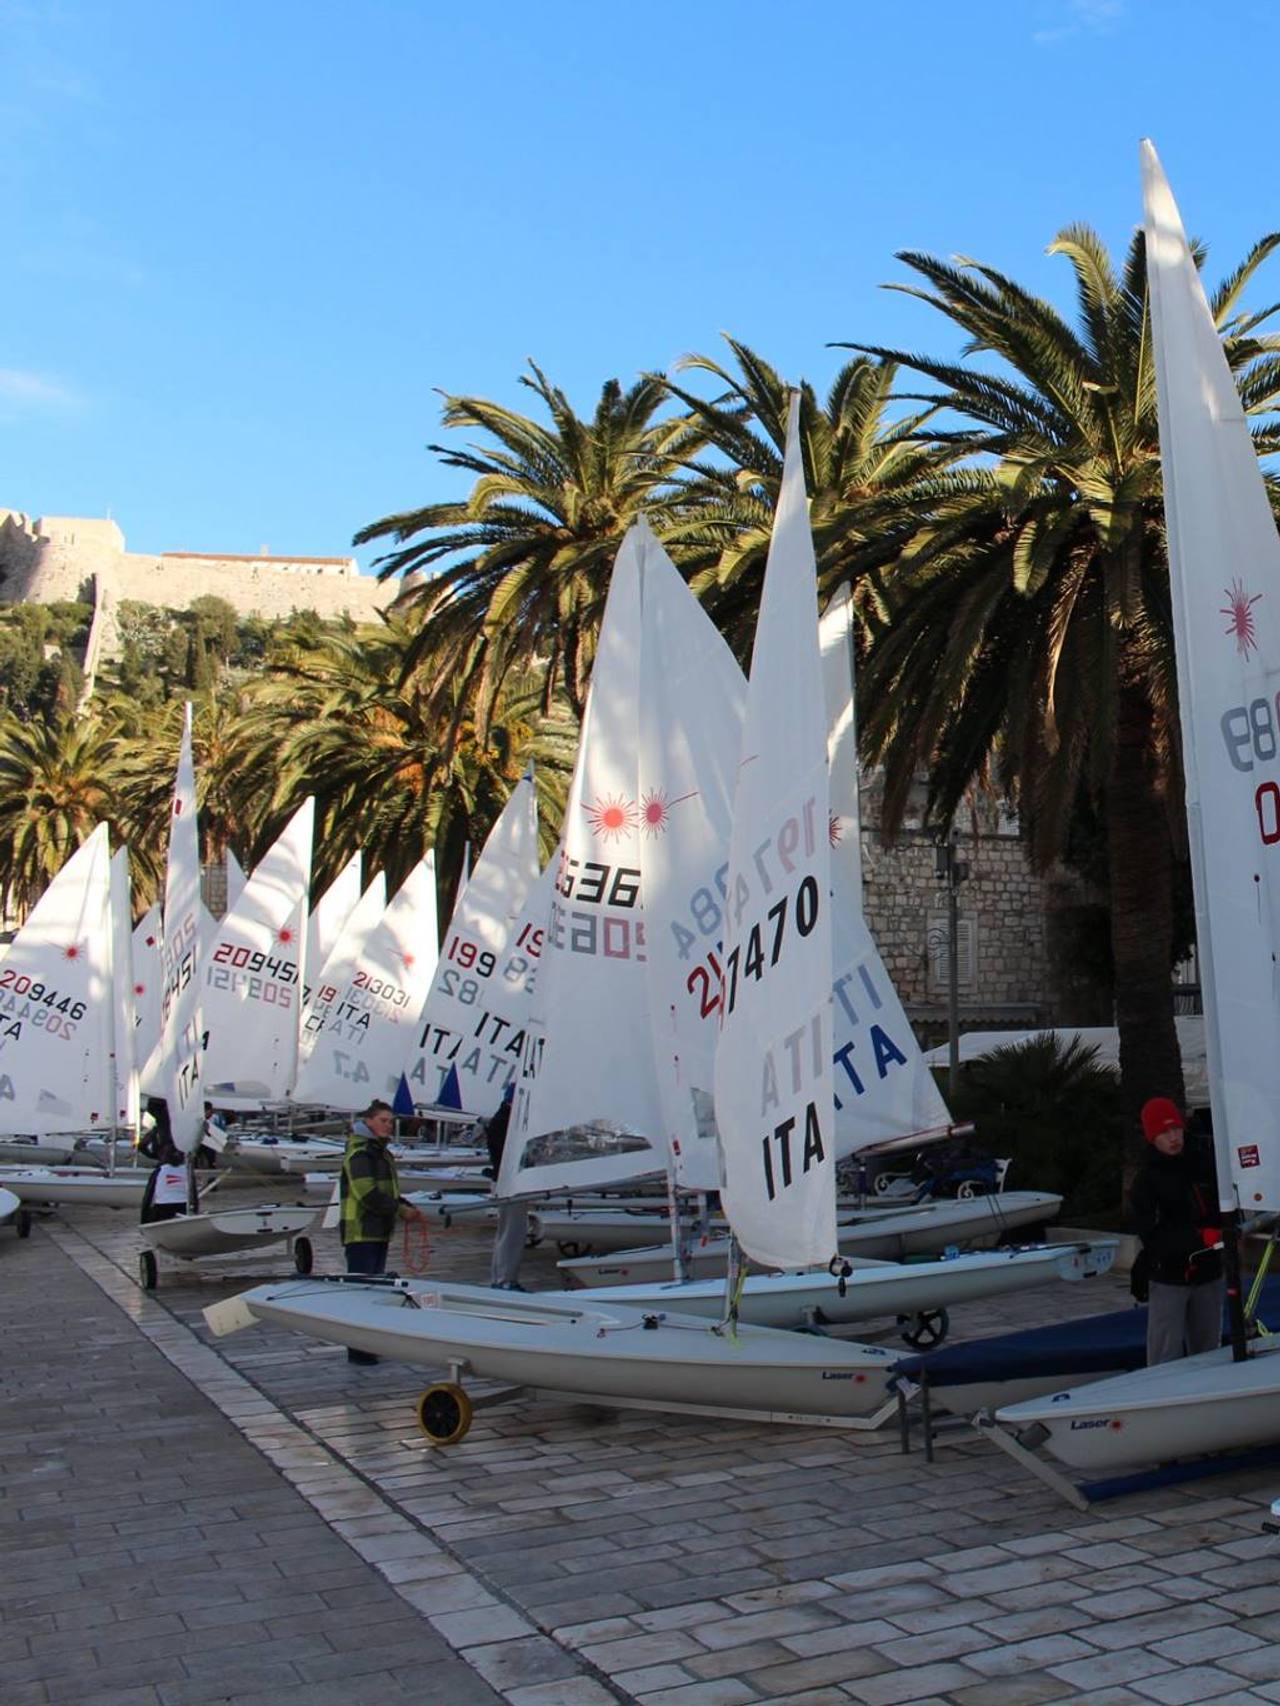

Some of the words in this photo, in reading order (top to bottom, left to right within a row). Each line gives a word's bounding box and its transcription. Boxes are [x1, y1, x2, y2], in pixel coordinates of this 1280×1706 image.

[213, 943, 300, 985] 209451
[0, 969, 87, 1021] 209446
[336, 1002, 371, 1030] ITA
[474, 1011, 525, 1058] ITA
[762, 1101, 825, 1202] ITA
[1071, 1419, 1110, 1431] Laser
